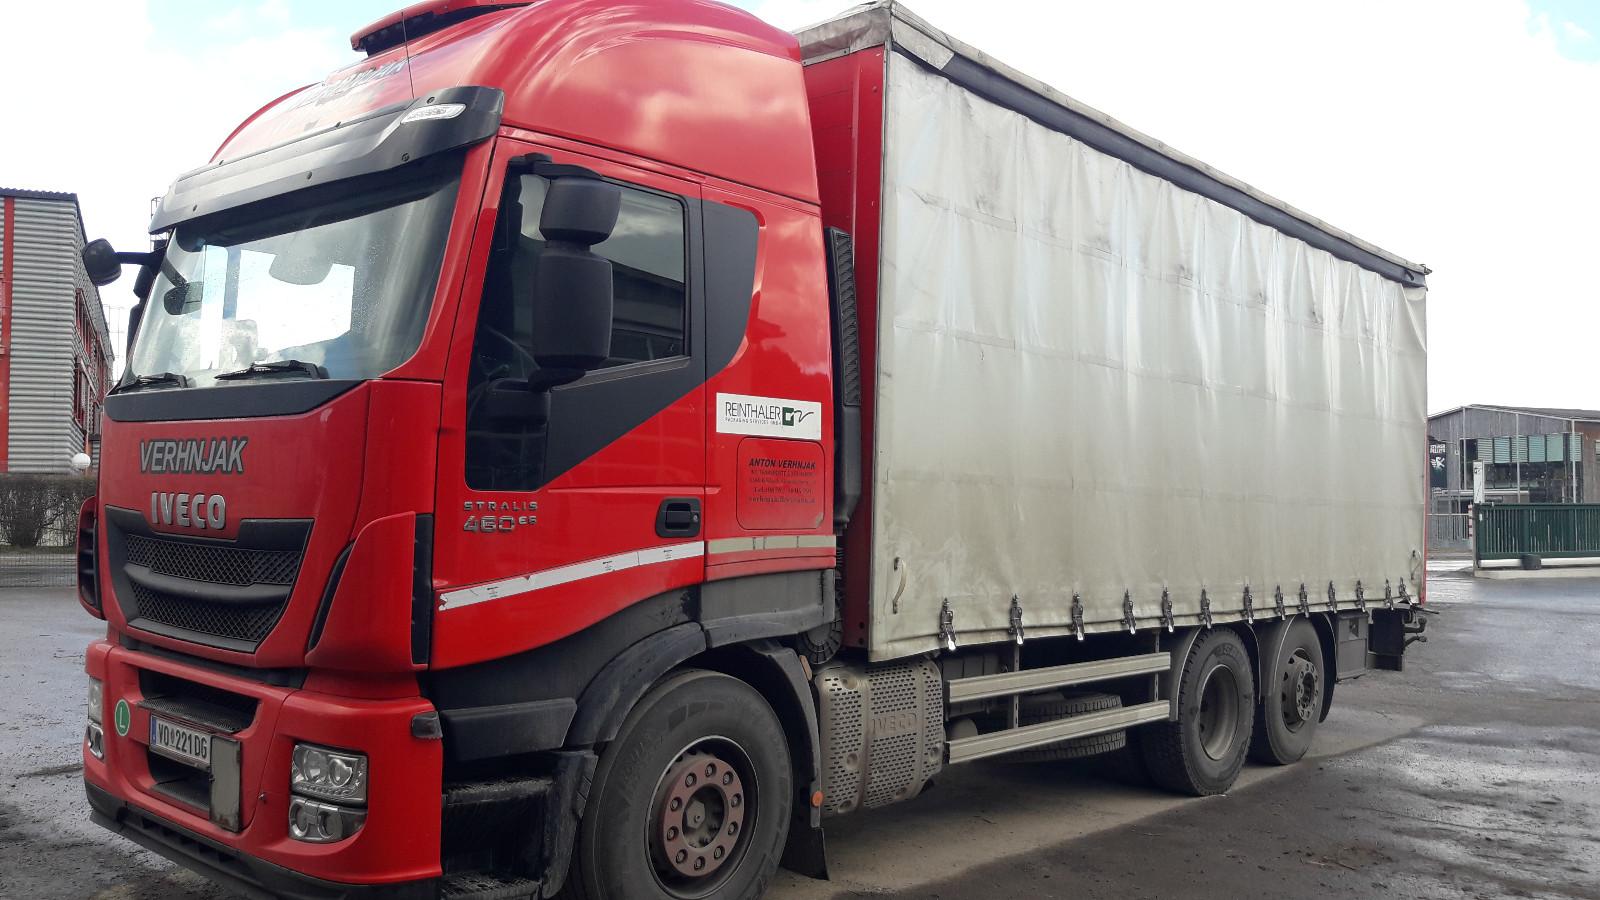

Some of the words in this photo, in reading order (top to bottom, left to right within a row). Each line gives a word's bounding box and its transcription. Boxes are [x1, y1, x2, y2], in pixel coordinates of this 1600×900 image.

[725, 402, 781, 420] REINTHALER
[140, 437, 248, 474] VERHNJAK
[749, 458, 775, 467] ANTON
[778, 460, 816, 469] VERHNJAK
[151, 491, 226, 530] IVECO
[463, 501, 538, 511] STRALIS
[463, 515, 515, 533] 460
[872, 713, 917, 734] IVECO
